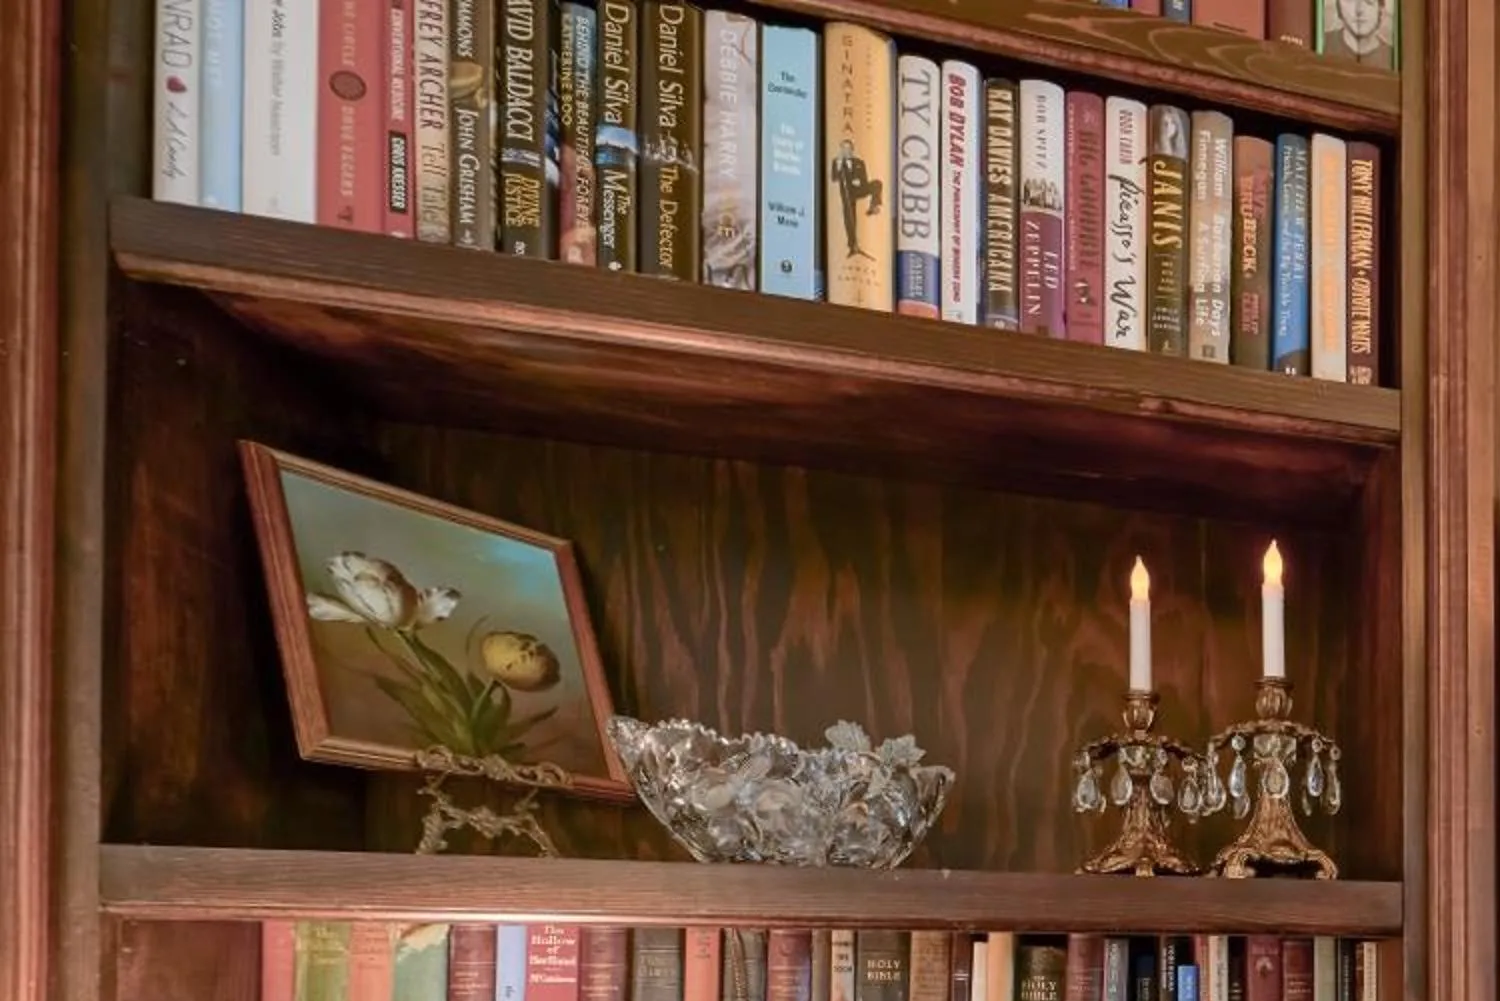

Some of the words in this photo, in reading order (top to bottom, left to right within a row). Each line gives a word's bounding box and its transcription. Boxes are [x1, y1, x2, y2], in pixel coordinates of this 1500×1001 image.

[560, 12, 573, 91] KATHERINE
[576, 15, 589, 68] BEHIND
[604, 1, 630, 72] Daniel
[658, 3, 684, 74] Daniel
[419, 53, 445, 131] ARCHER
[505, 45, 534, 141] BALDACCI
[576, 69, 589, 98] THE
[718, 28, 738, 105] DEBBIE
[948, 73, 967, 108] BOB
[604, 75, 630, 125] Silva
[658, 79, 685, 129] Silva
[901, 69, 932, 126] TY
[988, 89, 1012, 119] RAY
[455, 108, 480, 150] JOHN
[576, 100, 589, 172] BEAUTIFUL
[718, 110, 738, 179] HARRY
[948, 112, 967, 169] DYLAN
[988, 125, 1012, 185] DAVIES
[457, 152, 481, 225] GRISHAM
[660, 165, 679, 193] The
[901, 134, 932, 240] COBB
[1195, 129, 1210, 201] Finnegan
[1213, 137, 1227, 197] William
[1351, 159, 1373, 194] TONY
[504, 173, 524, 228] JUSTICE
[522, 177, 541, 228] DIVINE
[600, 169, 628, 249] Messenger
[616, 193, 631, 216] The
[1108, 174, 1146, 264] Picasso's
[1151, 159, 1183, 249] JANIS
[659, 199, 678, 269] Defector
[988, 192, 1012, 292] AMERICANA
[1351, 194, 1373, 269] HILLERMAN
[1025, 220, 1041, 318] ZEPPELIN
[1044, 251, 1059, 289] LED
[1110, 276, 1139, 340] War
[1195, 298, 1209, 327] Life
[1210, 298, 1226, 337] Days
[867, 959, 900, 969] HOLY
[867, 970, 901, 981] BIBLE
[1021, 980, 1058, 991] HOLY
[1021, 990, 1058, 1001] BIBLE
